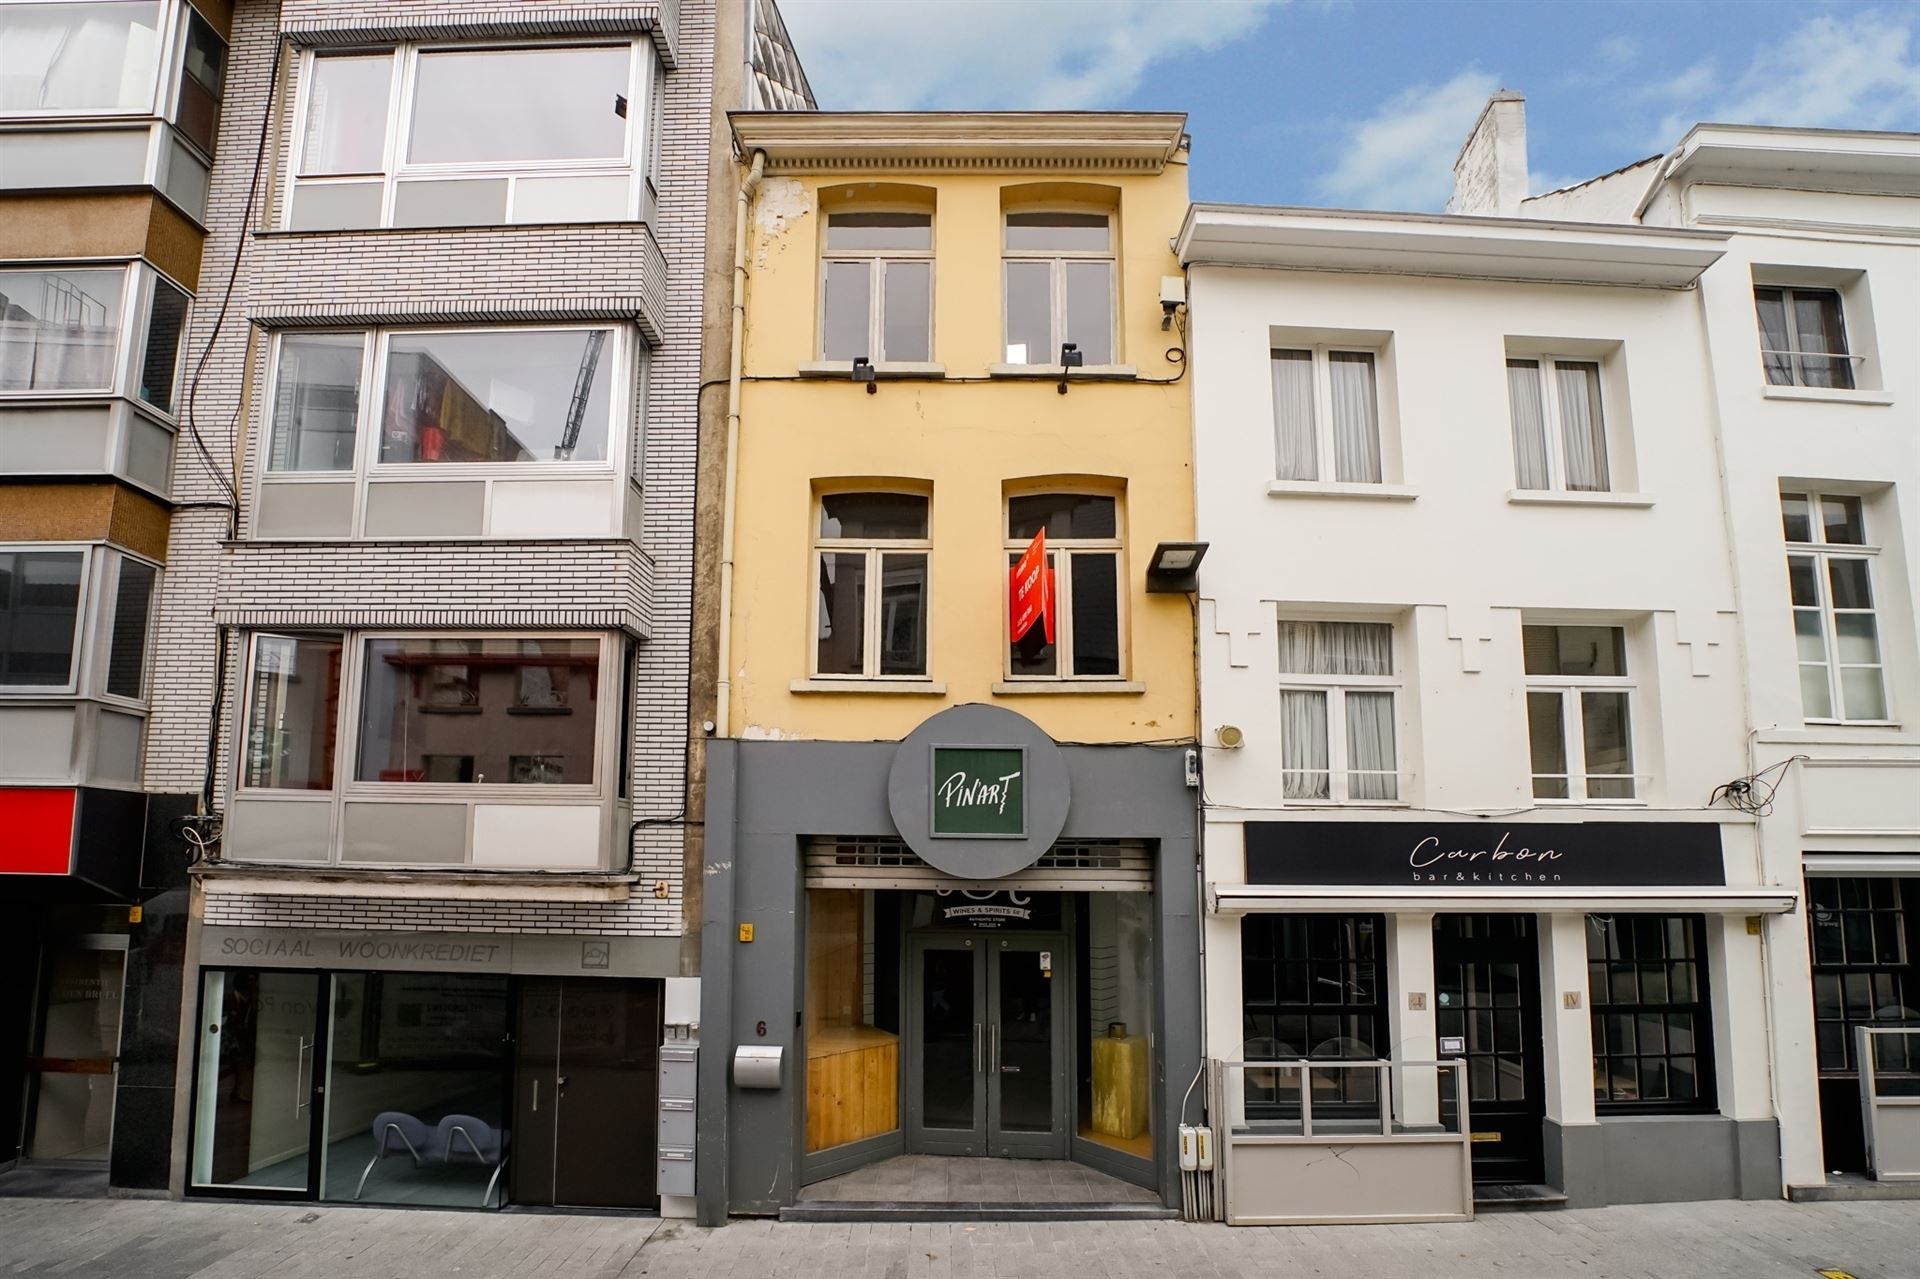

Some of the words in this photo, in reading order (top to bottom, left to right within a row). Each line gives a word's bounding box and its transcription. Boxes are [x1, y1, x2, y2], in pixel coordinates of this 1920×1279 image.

[1024, 564, 1040, 595] KOOP
[1410, 831, 1563, 868] Carbon
[1413, 872, 1561, 881] bar&kitchen
[952, 907, 975, 915] WINES
[221, 937, 315, 957] SOCIAAL
[339, 941, 500, 963] WOONKREDIET
[1566, 994, 1579, 1007] IV
[756, 1020, 767, 1037] 6
